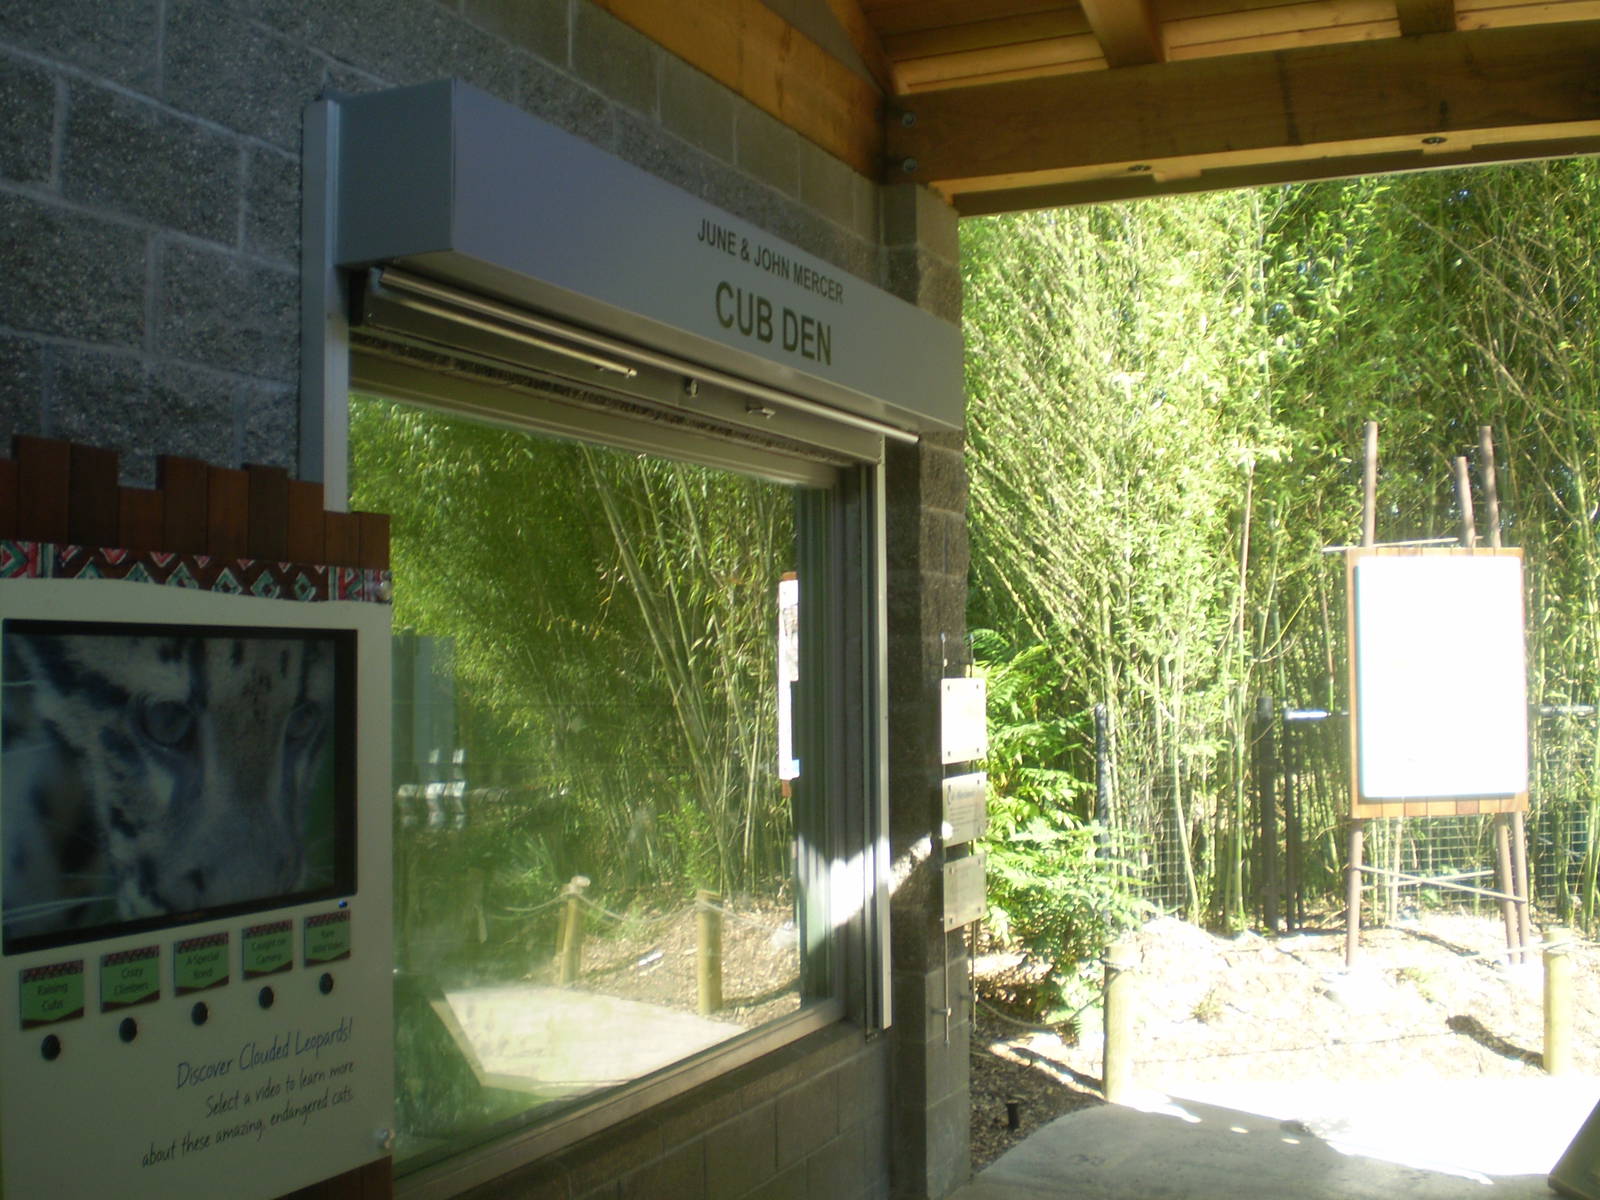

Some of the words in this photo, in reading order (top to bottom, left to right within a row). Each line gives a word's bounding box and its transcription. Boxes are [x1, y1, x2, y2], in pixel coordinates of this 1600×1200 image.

[697, 218, 737, 256] JUNE
[740, 237, 751, 263] &
[754, 245, 790, 280] JOHN
[793, 263, 844, 305] MERCER
[715, 280, 774, 344] CUB
[782, 307, 832, 366] DEN
[176, 1058, 234, 1089] Discover
[239, 1031, 291, 1070] Clouded
[296, 1017, 353, 1059] Leopards!
[206, 1089, 240, 1118] Select
[243, 1094, 250, 1105] a
[255, 1077, 281, 1101] video
[286, 1074, 295, 1093] to
[300, 1069, 326, 1088] learn
[330, 1061, 354, 1078] more
[142, 1143, 176, 1168] about
[182, 1131, 211, 1157] these
[270, 1088, 329, 1126] endangered
